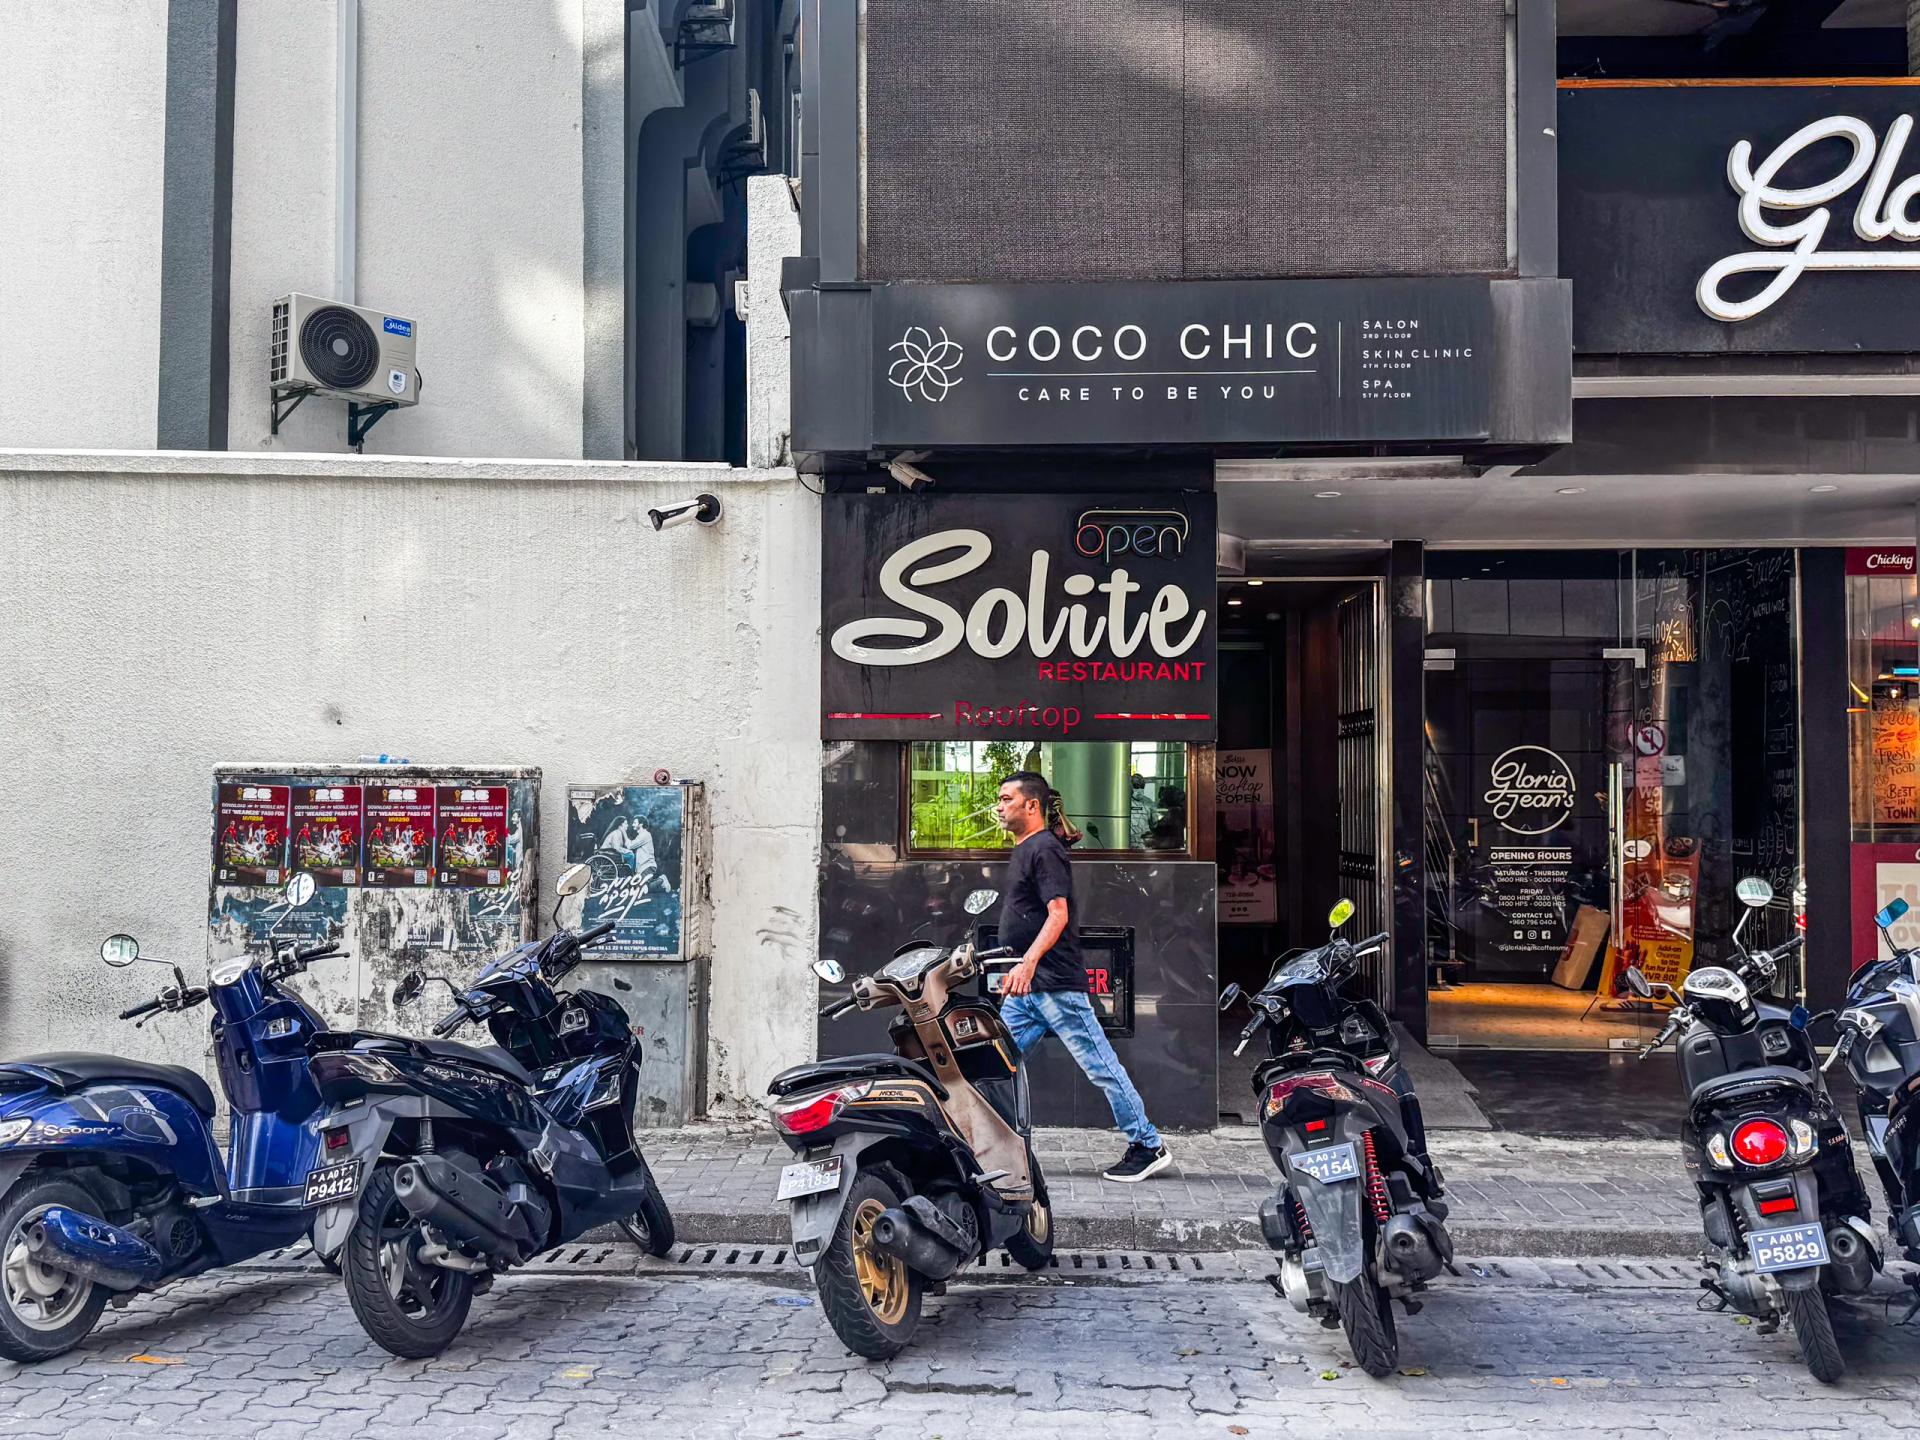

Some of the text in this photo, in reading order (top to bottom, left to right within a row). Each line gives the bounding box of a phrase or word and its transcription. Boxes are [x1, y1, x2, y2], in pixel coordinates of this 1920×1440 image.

[1362, 320, 1418, 329] SALON
[987, 323, 1317, 362] COCO CHIC
[1362, 348, 1472, 359] SKIN CLINIC
[1018, 386, 1275, 401] CARE TO BE YOU
[1362, 379, 1393, 389] SPA
[1076, 523, 1182, 565] open
[1866, 553, 1914, 570] Chicking
[830, 528, 1207, 667] Solite
[1038, 661, 1207, 682] RESTAURANT
[954, 699, 1081, 734] Rooftop
[1216, 765, 1257, 778] NOW
[1484, 761, 1568, 804] Gloria
[1225, 793, 1261, 803] OPEN
[1493, 790, 1575, 820] Jean's
[1490, 851, 1572, 860] OPENING HOURS
[1302, 1159, 1353, 1178] 8154
[307, 1177, 353, 1201] P9412
[1758, 1242, 1820, 1265] P5829
